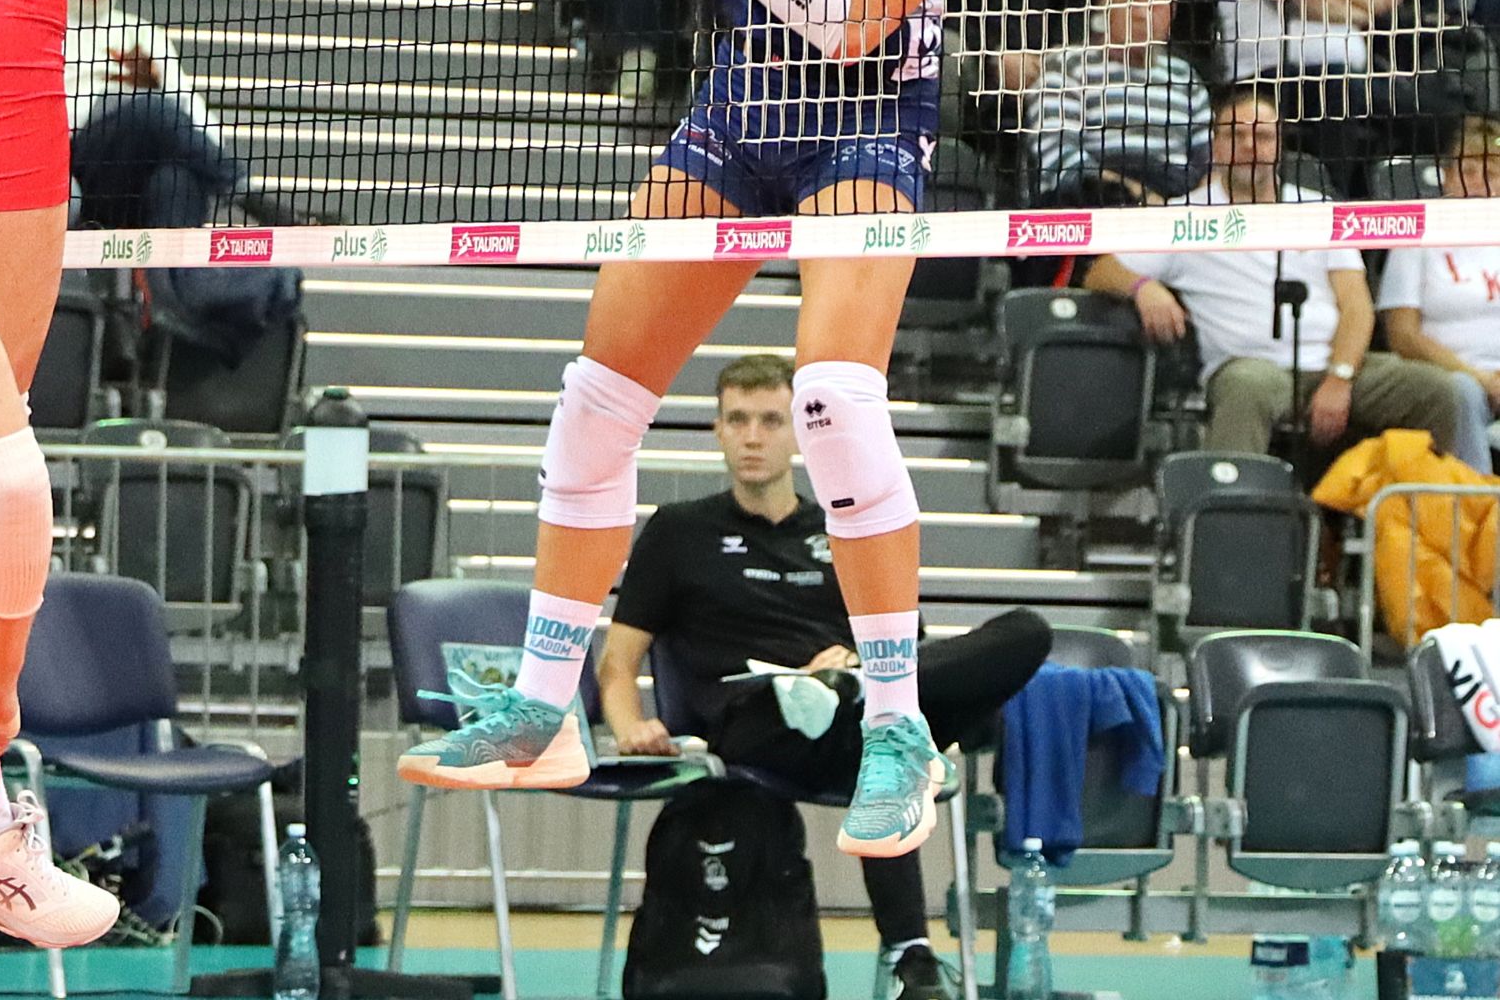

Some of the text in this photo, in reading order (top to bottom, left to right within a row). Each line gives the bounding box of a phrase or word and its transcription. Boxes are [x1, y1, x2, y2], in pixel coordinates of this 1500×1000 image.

[101, 211, 1417, 264] plus TAURON plus TAURON plus TAURON plus TAURON plus TAURON
